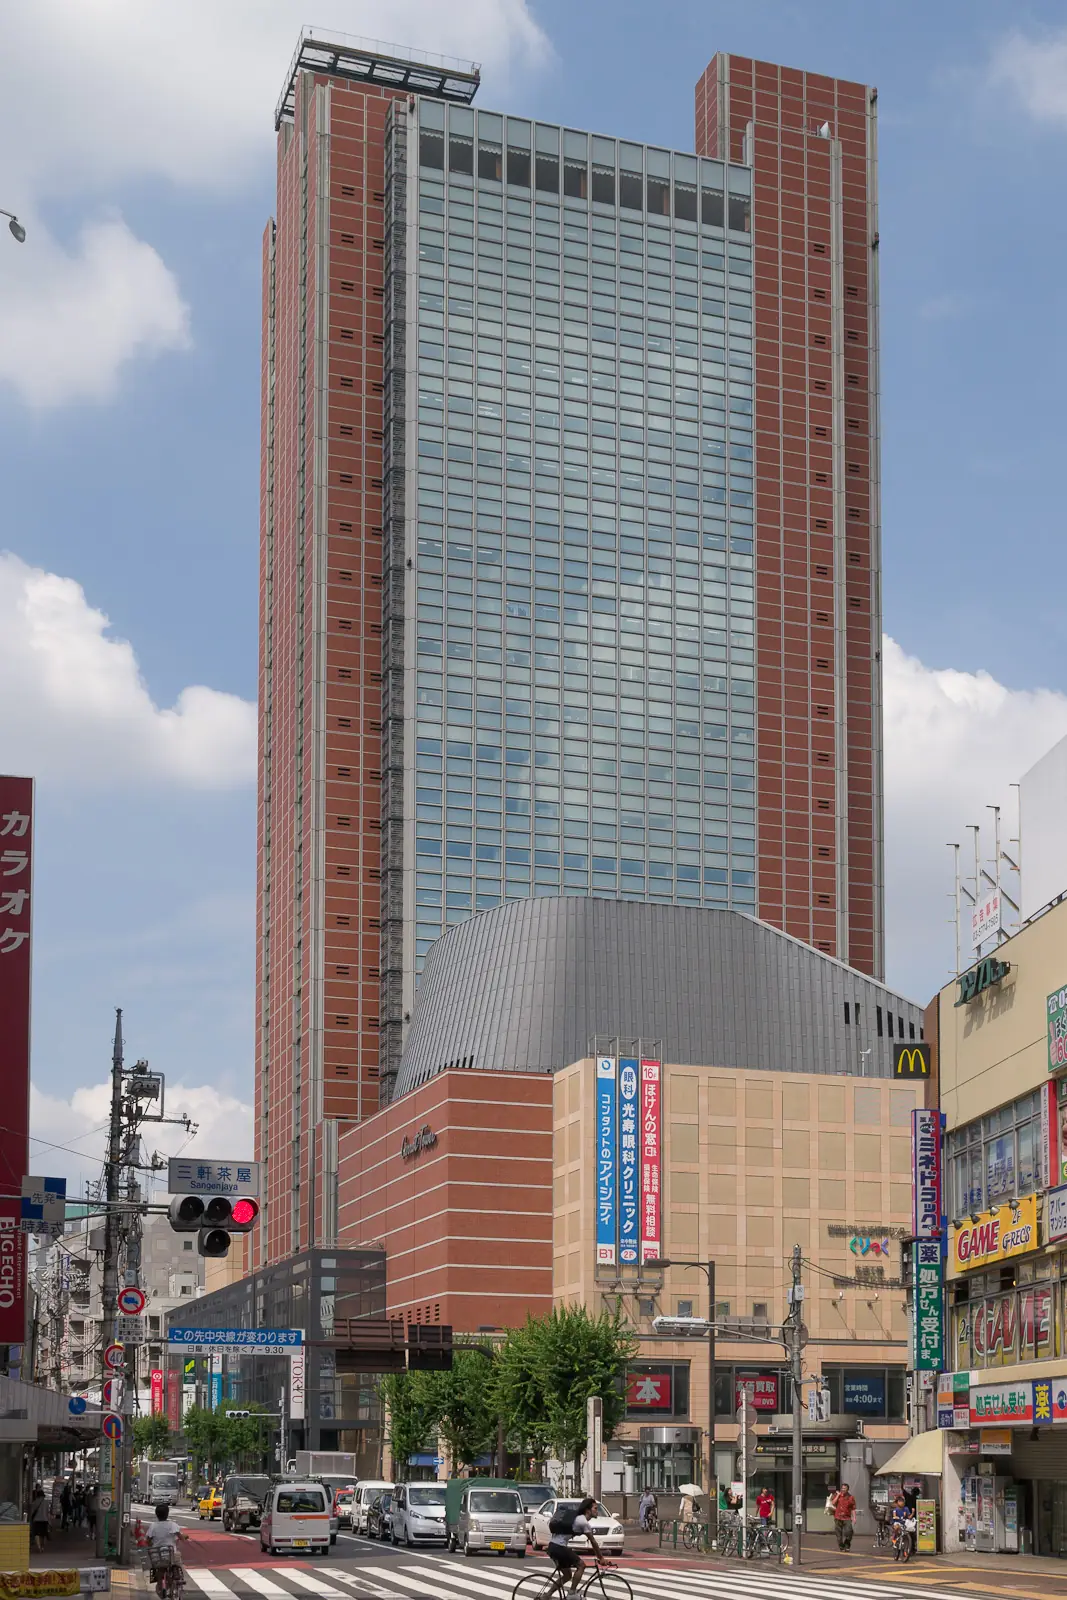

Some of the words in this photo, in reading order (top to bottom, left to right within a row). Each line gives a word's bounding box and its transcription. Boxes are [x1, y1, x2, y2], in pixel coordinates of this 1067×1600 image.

[0, 810, 30, 954] カラオケ
[623, 1071, 634, 1096] 眼科
[599, 1094, 613, 1225] コンタクトのアイシティ
[622, 1103, 636, 1234] 光寿眼科クリニック
[177, 1165, 252, 1183] 三軒茶屋
[190, 1180, 239, 1192] Sangenjaya
[918, 1137, 937, 1230] ミネドラッグ
[31, 1192, 57, 1204] 先発
[20, 1220, 64, 1235] 時差式
[645, 1193, 656, 1238] 無料相談
[1011, 1209, 1022, 1226] 2F
[599, 1248, 613, 1260] B1
[849, 1236, 889, 1255] くりっく
[919, 1244, 939, 1263] 薬
[957, 1220, 1000, 1263] GAME
[623, 1250, 634, 1260] 2F
[919, 1268, 941, 1367] 処方せん受付ます
[974, 1288, 1051, 1357] GAME
[173, 1330, 298, 1344] この先中央線が変わります
[110, 1352, 123, 1364] 40
[292, 1357, 304, 1404] TOKYU
[635, 1376, 661, 1404] 本
[975, 1392, 1026, 1417] 処方せん受付
[1035, 1384, 1050, 1419] 薬
